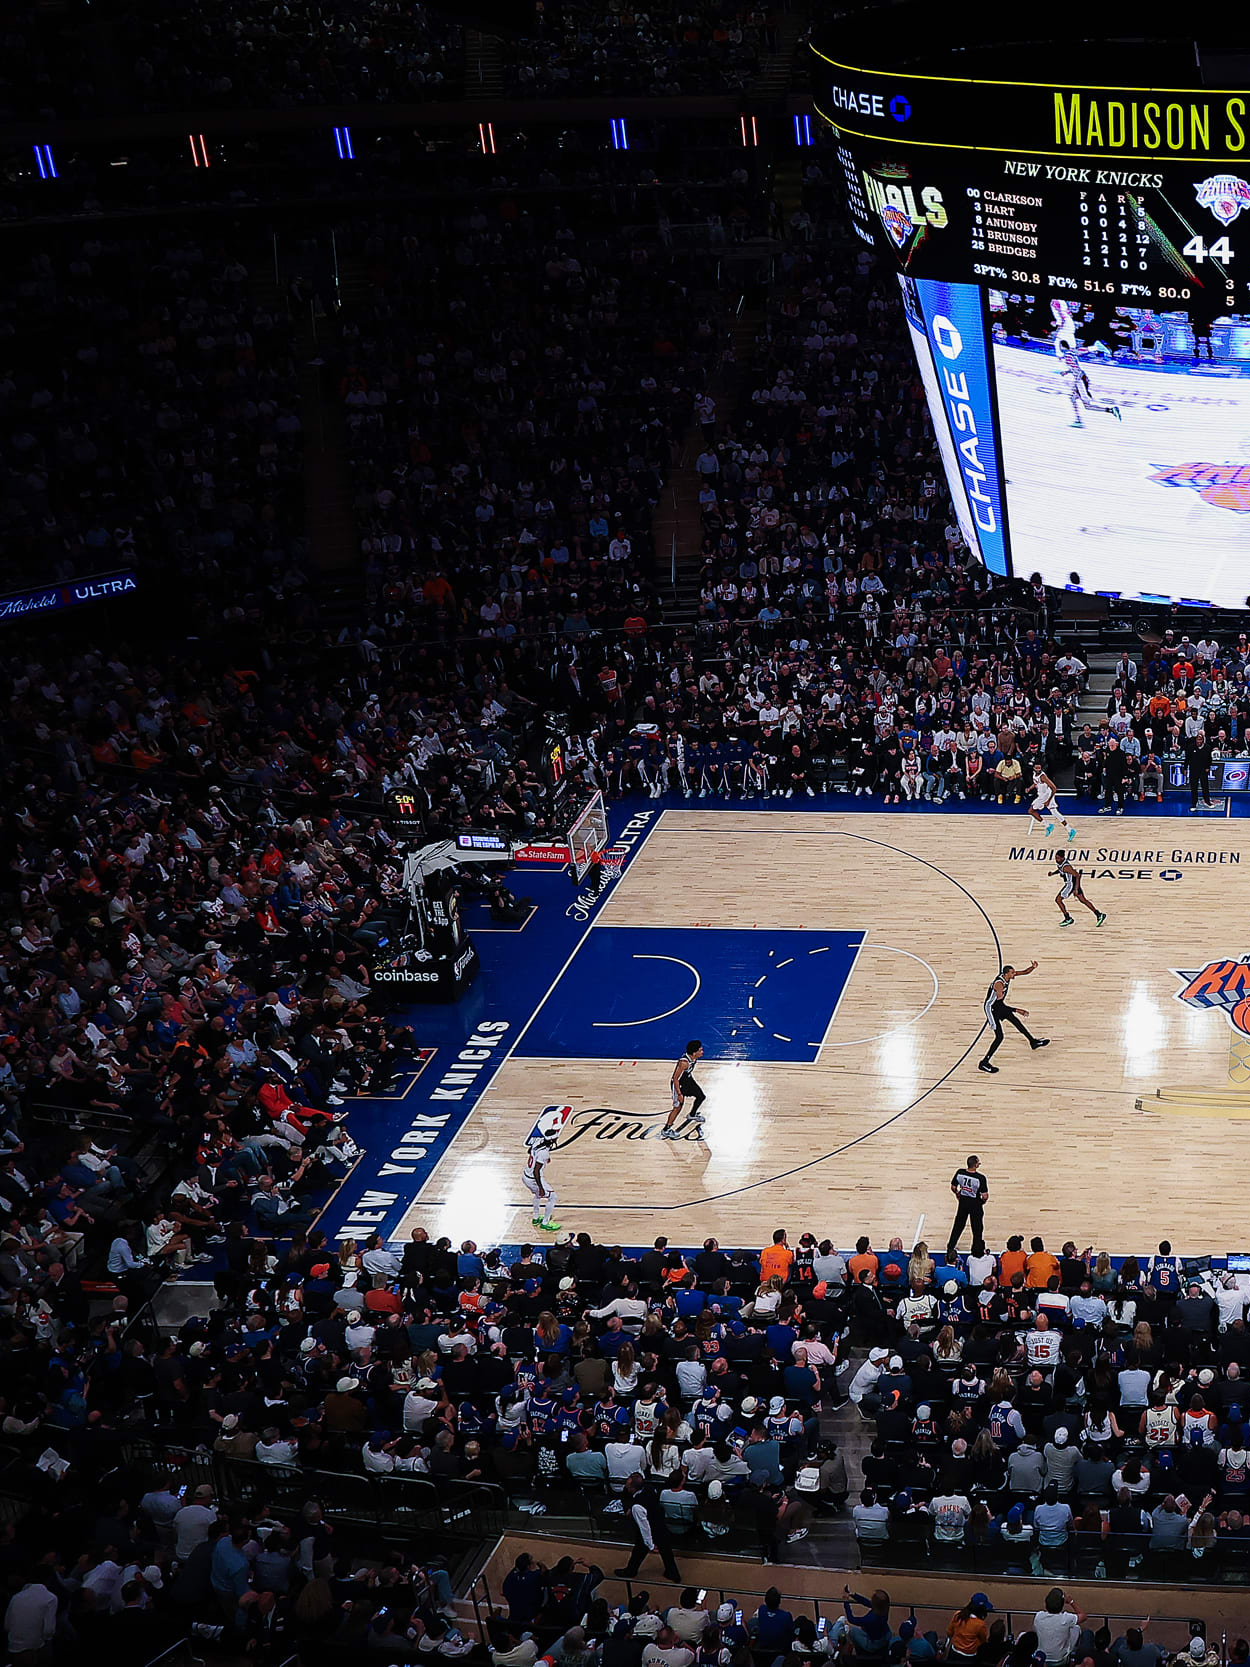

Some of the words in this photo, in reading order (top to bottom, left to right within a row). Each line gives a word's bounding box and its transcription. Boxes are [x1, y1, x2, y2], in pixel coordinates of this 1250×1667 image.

[833, 85, 885, 117] CHASE
[1054, 92, 1210, 150] MADISON
[1004, 160, 1041, 177] NEW
[1045, 165, 1091, 183] YORK
[1096, 170, 1164, 189] KNICKS
[862, 169, 949, 229] FINALS
[967, 187, 981, 199] 00
[983, 190, 1043, 207] CLARKSON
[1080, 203, 1088, 212] 0
[1098, 204, 1107, 213] 0
[1119, 206, 1126, 216] 1
[1137, 207, 1145, 217] 5
[1080, 192, 1087, 200] F
[1098, 193, 1107, 202] A
[1117, 195, 1126, 203] R
[1137, 196, 1145, 204] P
[974, 202, 981, 212] 3
[985, 204, 1015, 217] HART
[1080, 216, 1089, 226] 0
[1099, 218, 1108, 227] 0
[1118, 219, 1127, 229] 4
[1137, 221, 1146, 230] 8
[975, 215, 983, 225] 8
[986, 217, 1038, 233] ANUNOBY
[1083, 230, 1089, 239] 1
[1101, 232, 1108, 241] 1
[1119, 233, 1127, 242] 2
[1136, 235, 1150, 244] 12
[972, 228, 984, 238] 11
[987, 230, 1038, 246] BRUNSON
[1083, 243, 1090, 252] 1
[1101, 245, 1109, 254] 2
[1121, 247, 1127, 256] 1
[1138, 248, 1147, 257] 7
[1183, 235, 1235, 265] 44
[971, 240, 985, 250] 25
[988, 243, 1036, 259] BRIDGES
[1083, 256, 1091, 265] 2
[1103, 258, 1109, 267] 1
[1120, 260, 1128, 269] 0
[1139, 261, 1148, 271] 0
[973, 263, 1007, 279] 3PT%
[1011, 270, 1041, 284] 30.8
[1048, 275, 1078, 289] FG%
[1083, 280, 1115, 293] 51.6
[1121, 283, 1151, 297] FT%
[1158, 286, 1191, 299] 80.0
[1225, 279, 1235, 290] 3
[1225, 295, 1235, 306] 5
[943, 366, 996, 534] CHASE
[75, 578, 136, 599] ULTRA
[395, 795, 415, 804] 5:04
[399, 803, 415, 814] 17
[609, 810, 655, 856] ULTRA
[528, 850, 565, 860] StateFarm
[1095, 847, 1164, 863] SQUARE
[1171, 850, 1240, 865] GARDEN
[1077, 869, 1153, 881] HASE
[374, 969, 439, 982] coinbase
[334, 1190, 399, 1241] NEW
[378, 1112, 453, 1177] YORK
[430, 1020, 510, 1101] KNICKS
[799, 1266, 813, 1280] 14
[1160, 1270, 1170, 1286] 5
[702, 1340, 720, 1353] 33
[1034, 1345, 1050, 1358] 15
[636, 1419, 653, 1432] 32
[991, 1421, 1002, 1438] 11
[1149, 1428, 1169, 1441] 25
[1226, 1468, 1246, 1482] 25
